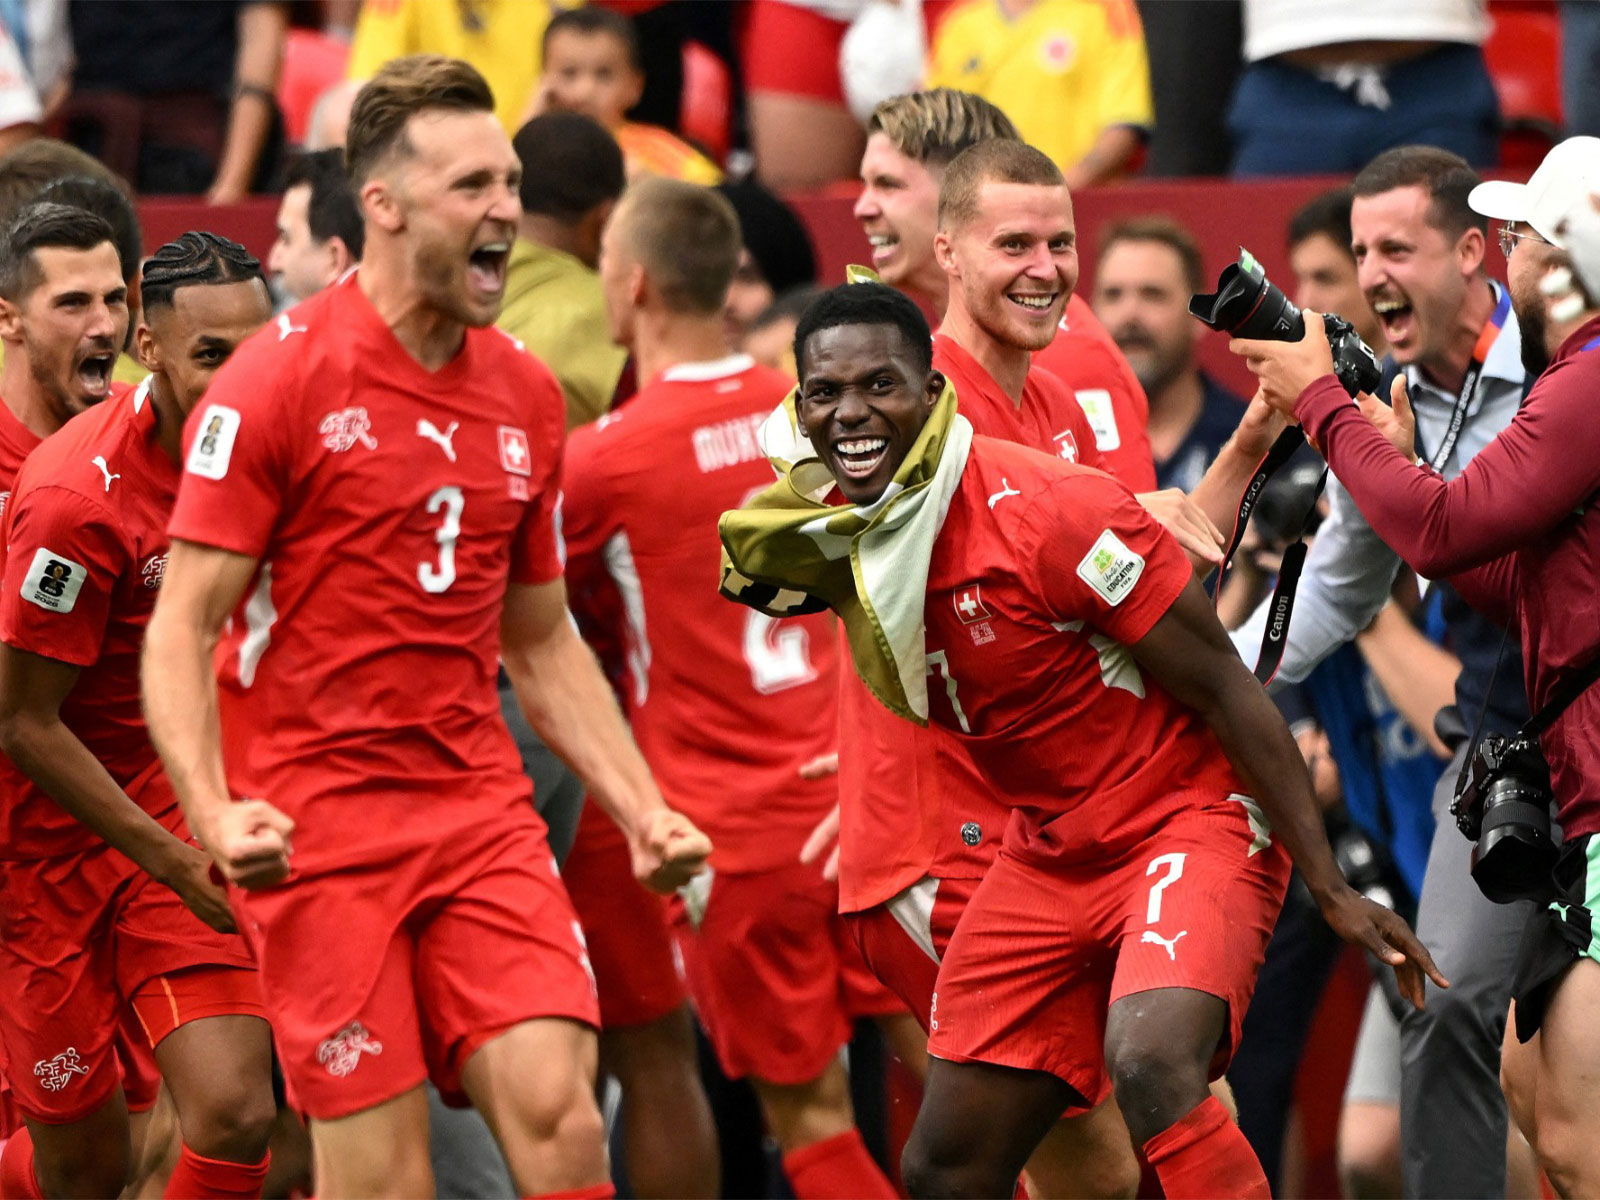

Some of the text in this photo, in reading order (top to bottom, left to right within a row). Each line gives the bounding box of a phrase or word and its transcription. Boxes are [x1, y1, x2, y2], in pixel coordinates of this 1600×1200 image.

[1433, 431, 1457, 469] WORLD
[1450, 410, 1463, 432] CUP
[1247, 473, 1266, 501] EOS
[417, 485, 465, 593] 3
[1106, 560, 1136, 593] EDUCATION
[1120, 576, 1133, 589] FIFA
[1269, 595, 1289, 642] Canon
[1145, 852, 1190, 925] 7
